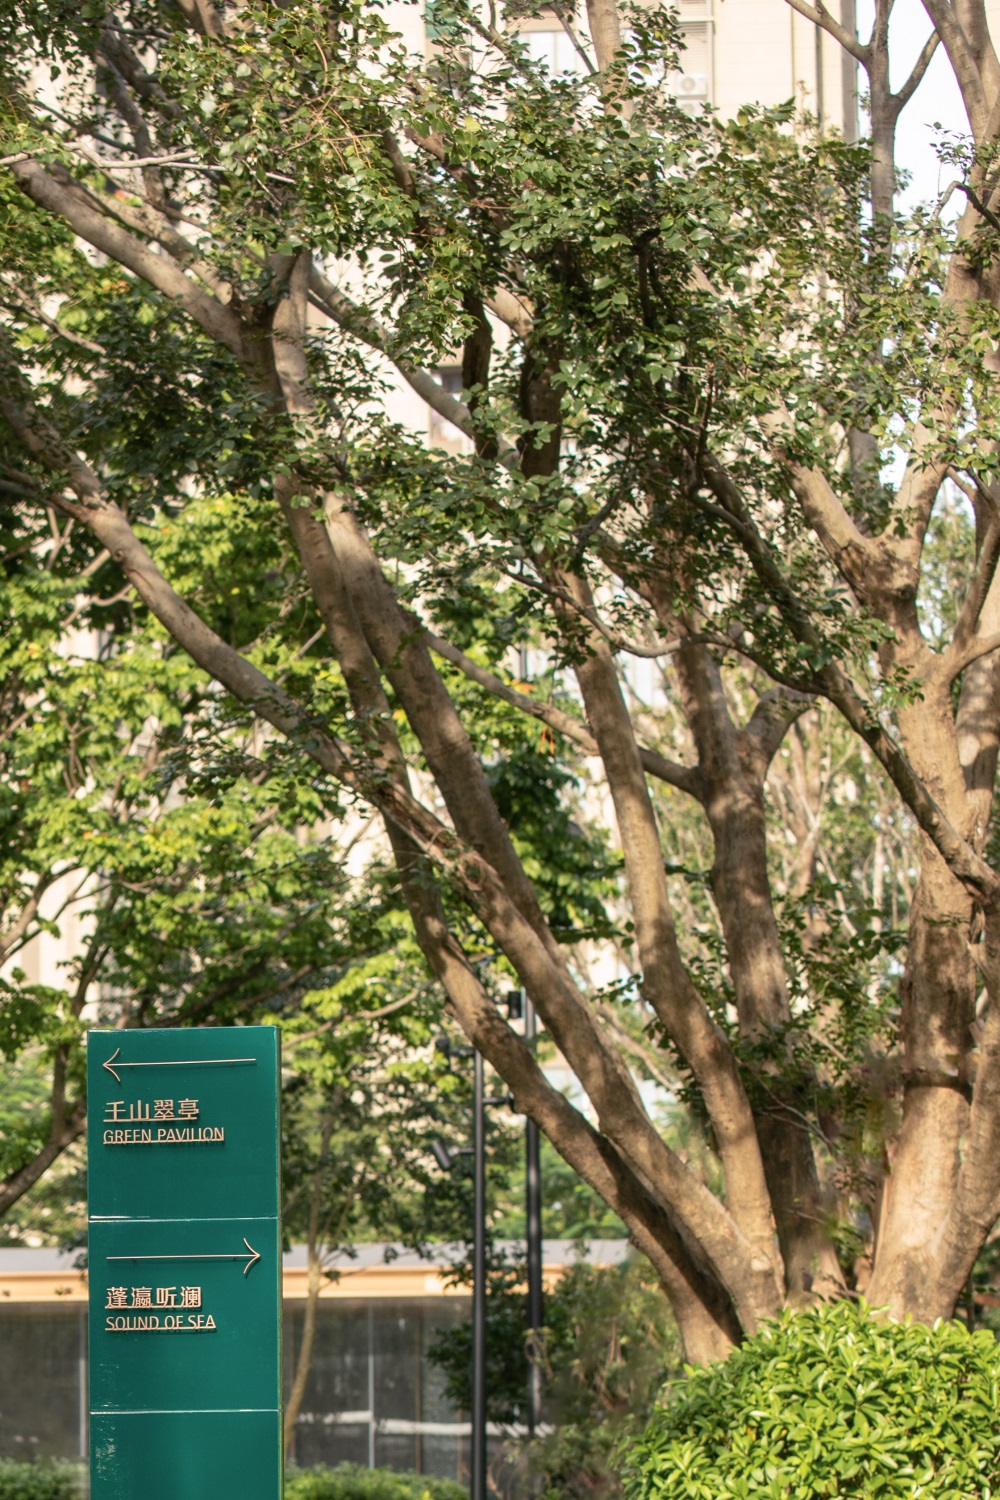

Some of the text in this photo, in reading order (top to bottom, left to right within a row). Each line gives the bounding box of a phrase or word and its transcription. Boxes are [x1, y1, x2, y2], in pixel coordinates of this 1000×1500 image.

[103, 1098, 199, 1122] 千山翠亭
[103, 1127, 224, 1144] GREEN PAVILION
[105, 1286, 202, 1309] 蓬瀛听澜
[105, 1314, 217, 1331] SOUND OF SEA
